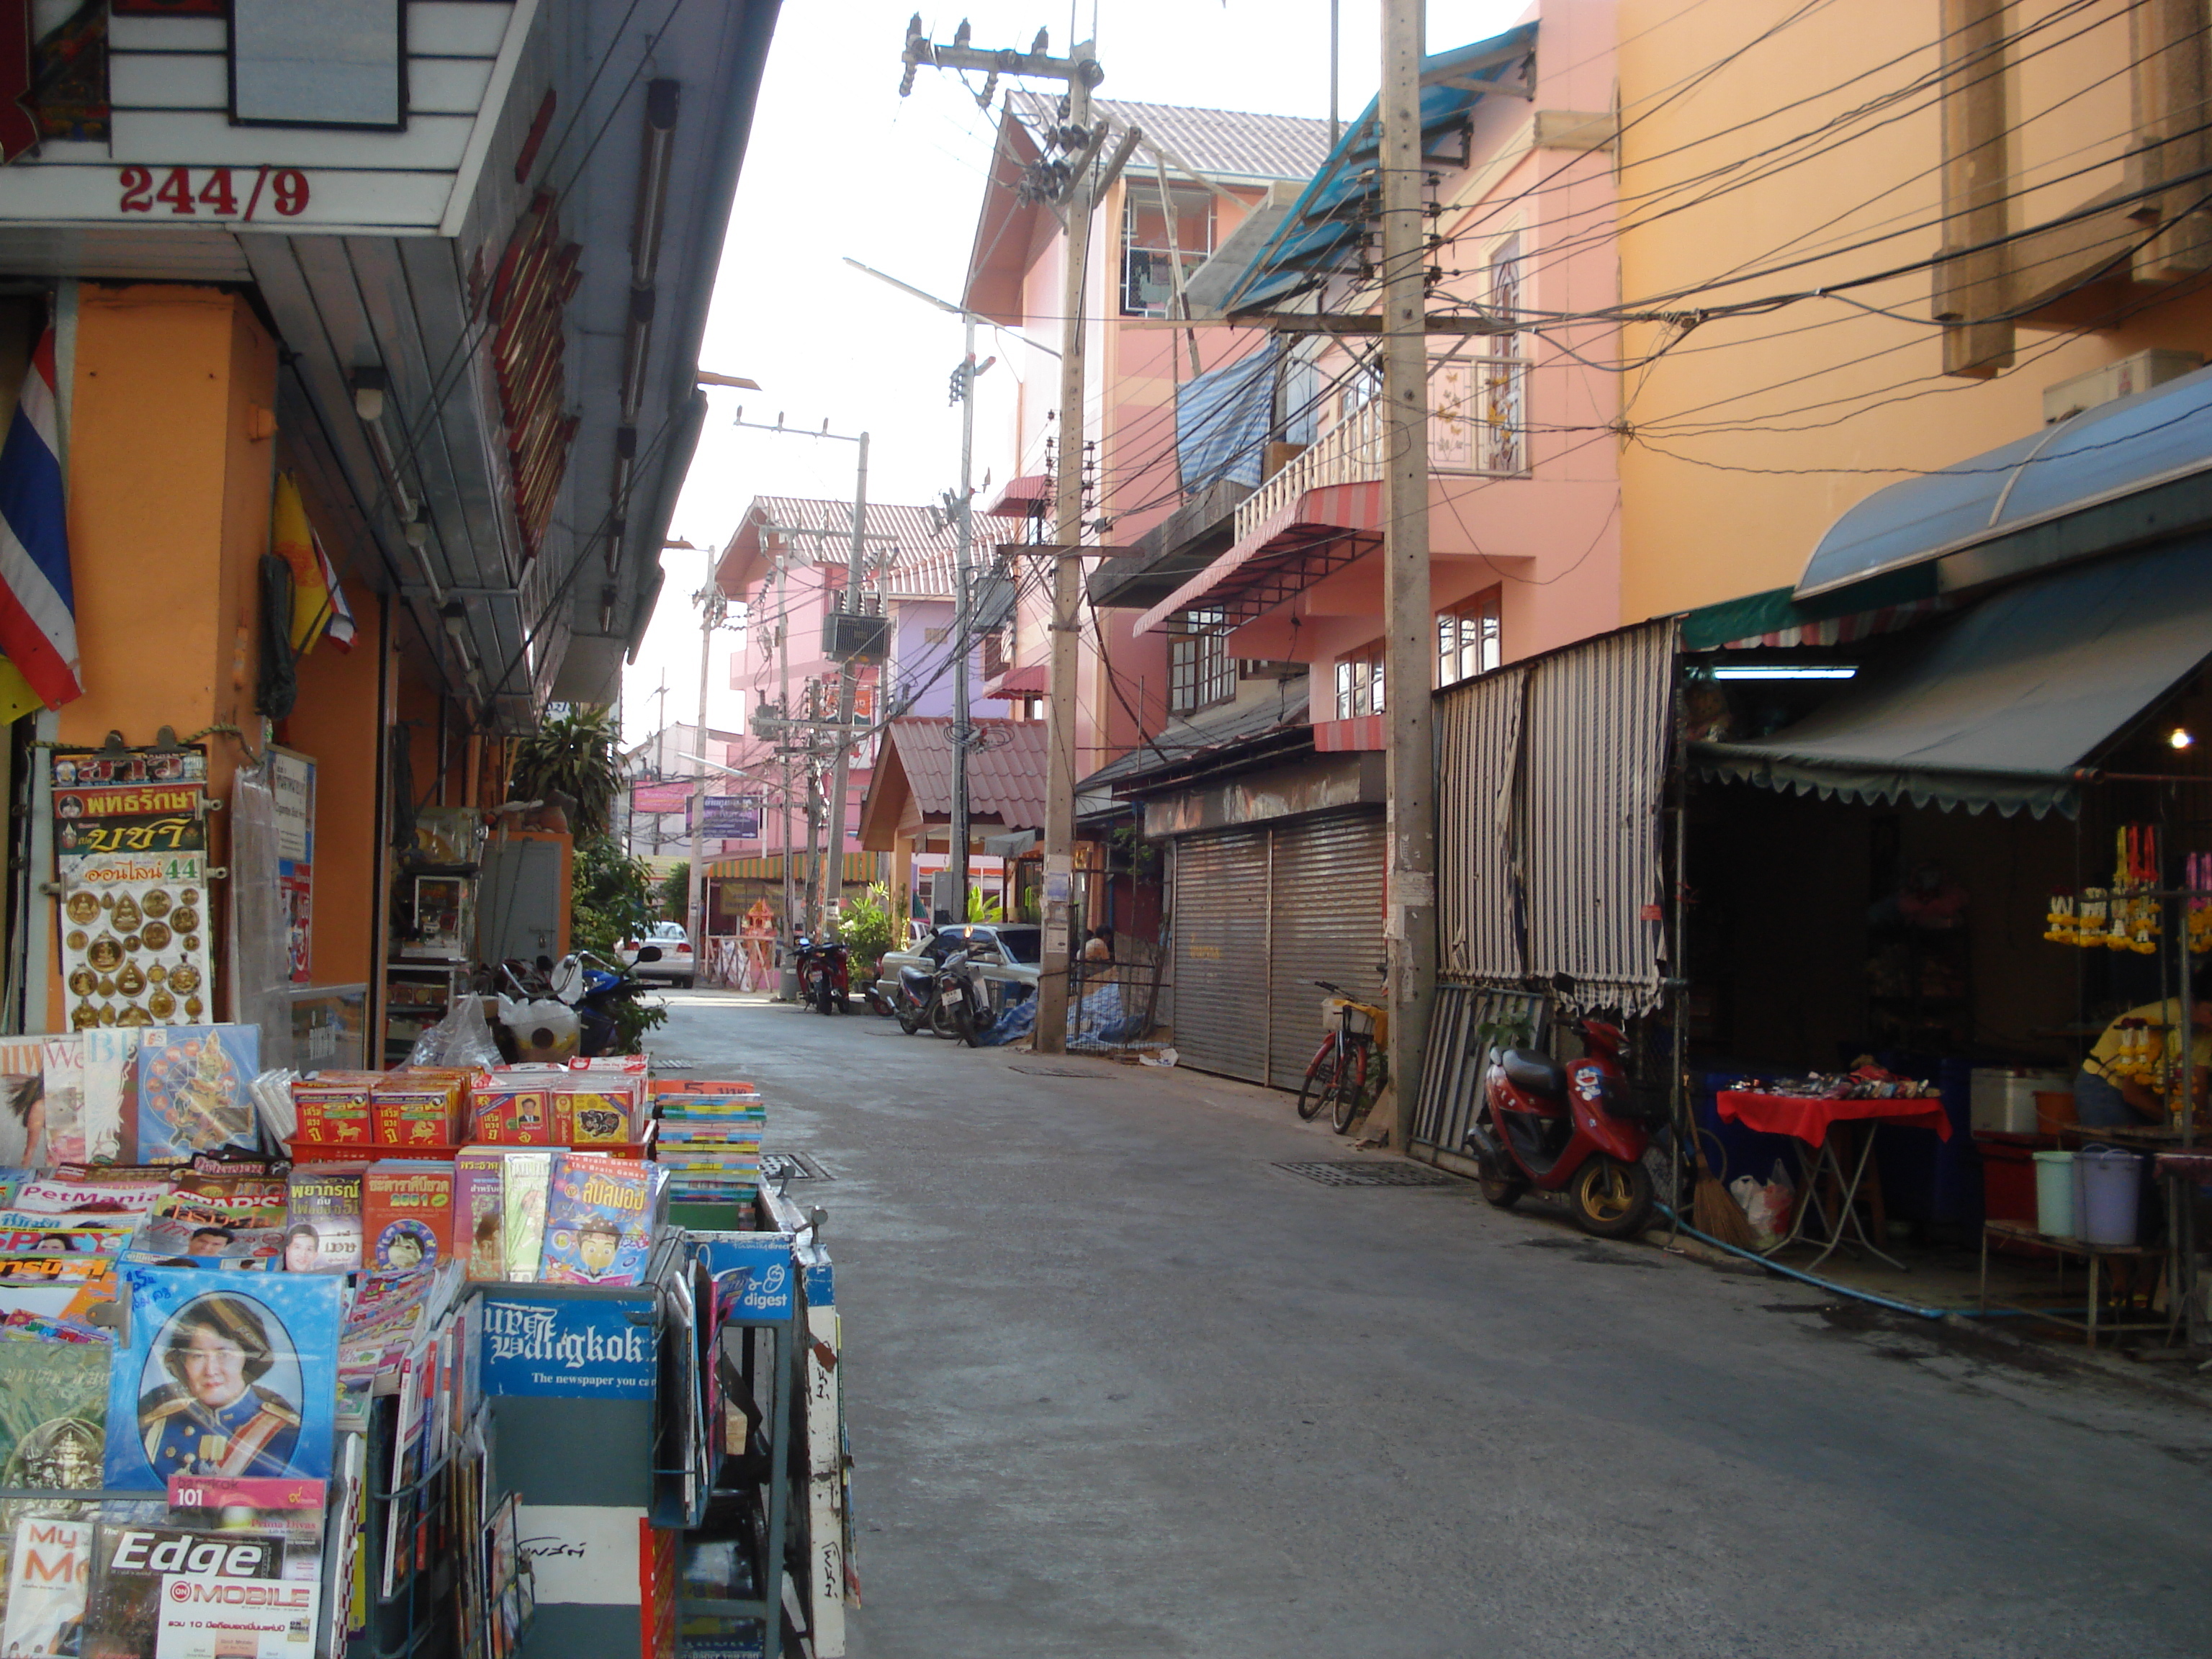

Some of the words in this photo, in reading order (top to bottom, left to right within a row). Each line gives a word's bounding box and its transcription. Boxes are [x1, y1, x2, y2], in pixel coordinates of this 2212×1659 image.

[120, 164, 310, 221] 244/9
[87, 788, 197, 815] พทธรักษา
[85, 860, 163, 881] ออนไลน์
[166, 859, 198, 879] 44
[24, 1186, 161, 1204] PetMania
[390, 1193, 428, 1207] 2551
[744, 1292, 788, 1309] digest
[531, 1372, 553, 1384] The
[556, 1375, 613, 1388] newspaper
[616, 1377, 636, 1388] you
[178, 1488, 203, 1506] 101
[251, 1519, 283, 1529] Prima
[286, 1519, 315, 1529] Divas
[30, 1524, 77, 1549] My
[111, 1531, 263, 1577] Edge
[193, 1583, 310, 1608] MOBILE
